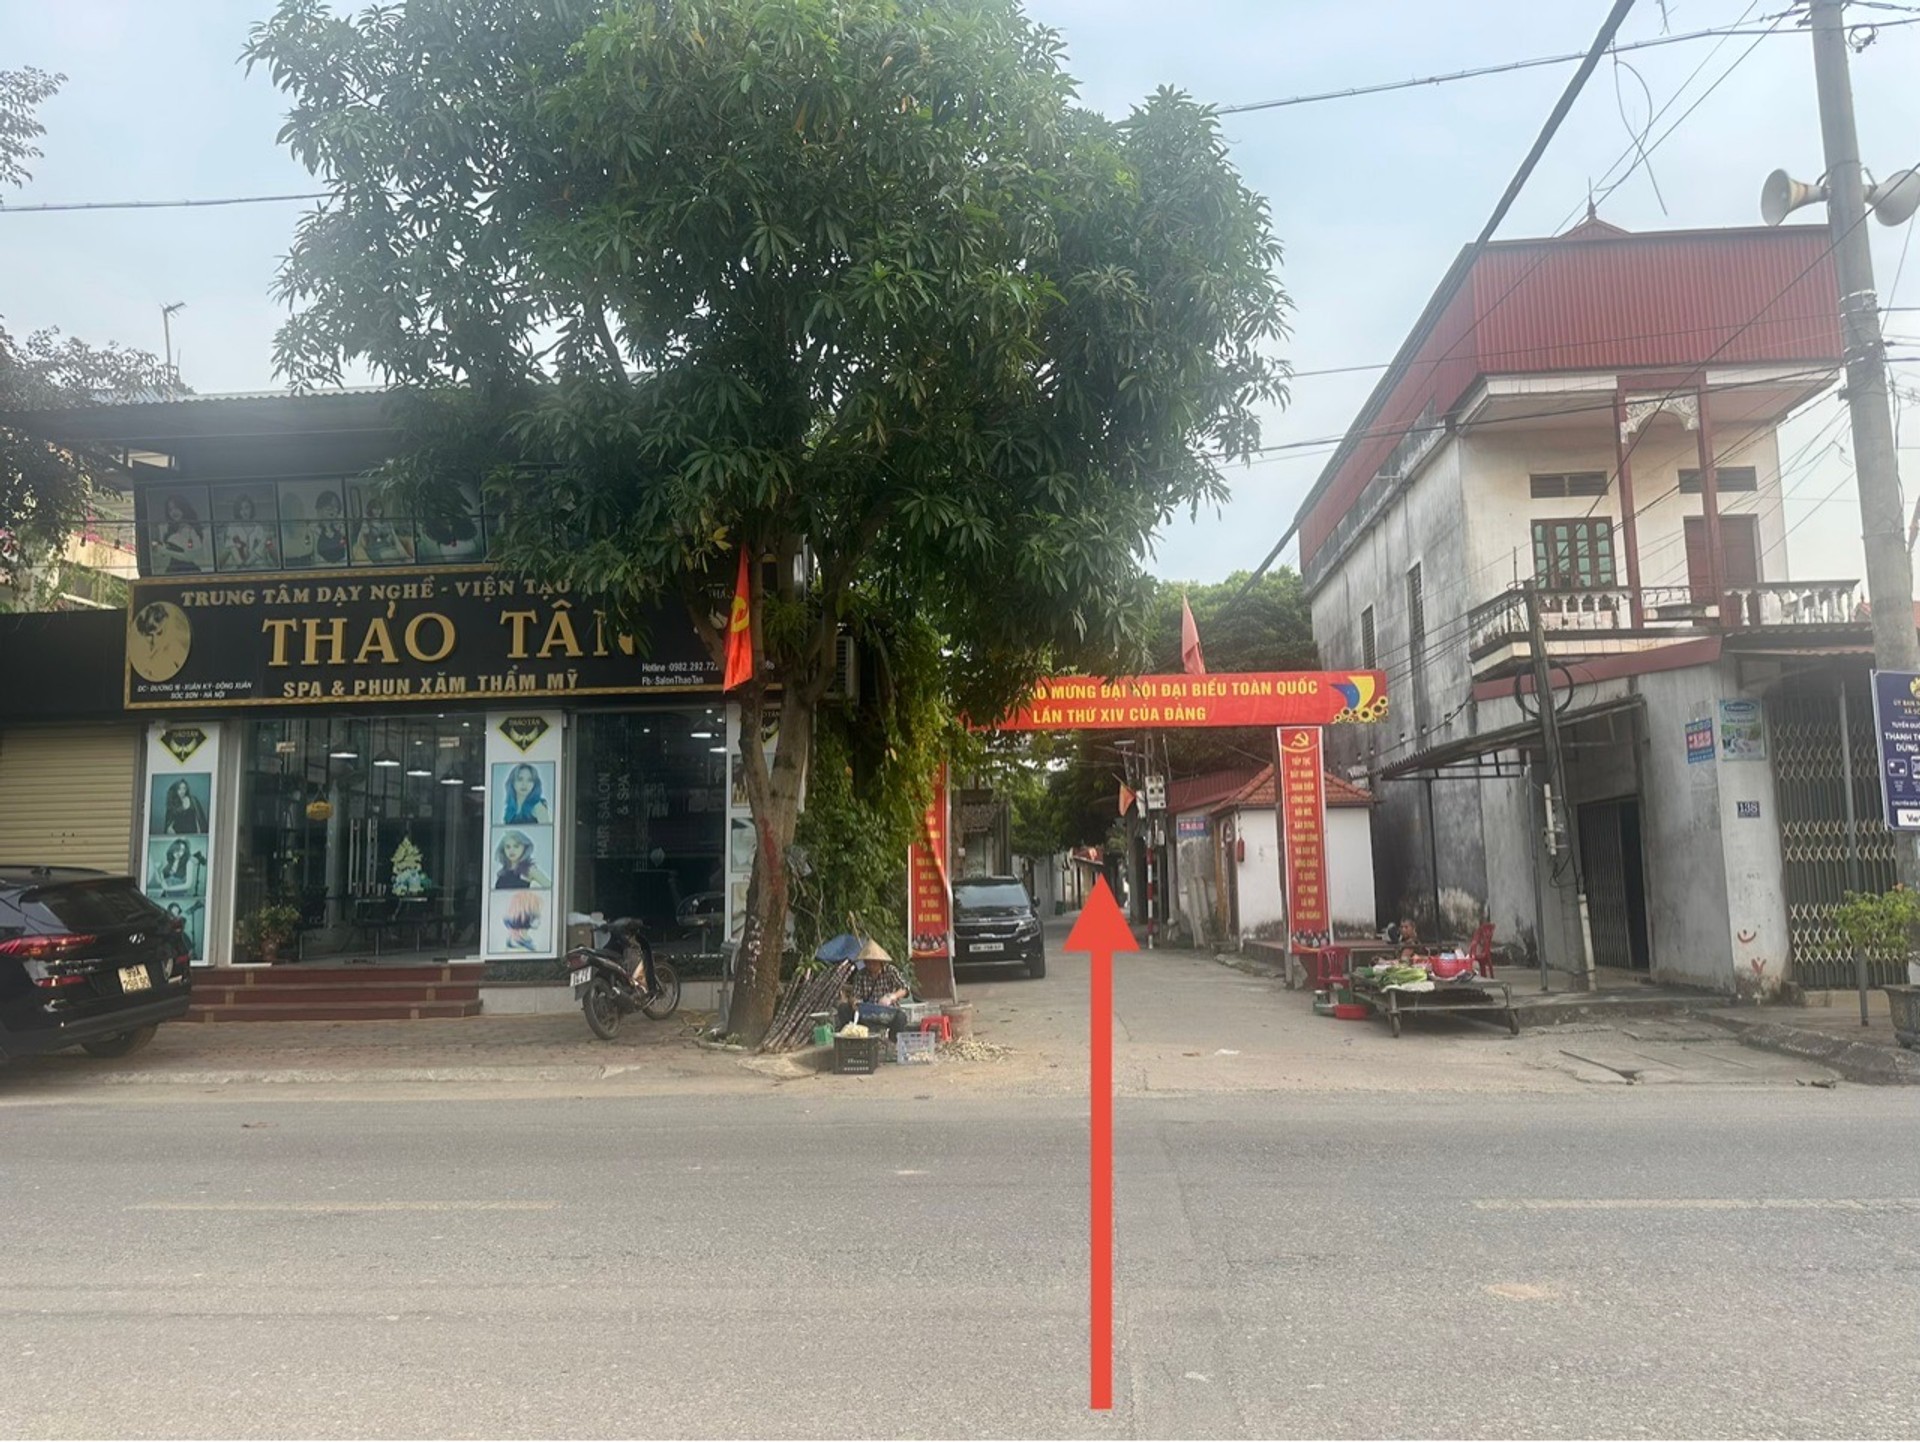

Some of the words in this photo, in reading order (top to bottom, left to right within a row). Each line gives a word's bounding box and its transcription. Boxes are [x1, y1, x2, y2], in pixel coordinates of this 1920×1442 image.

[181, 589, 256, 607] TRUNG
[262, 583, 310, 605] TÂM
[317, 585, 363, 608] DẠY
[370, 575, 436, 600] NGHỀ
[455, 575, 516, 602] VIỆN
[261, 600, 456, 666] THẢO
[282, 681, 322, 698] SPA
[330, 680, 345, 696] &
[354, 677, 410, 696] PHUN
[419, 671, 467, 694] XĂM
[477, 664, 537, 692] THẨM
[546, 668, 579, 690] MỸ
[1051, 683, 1097, 699] MỪNG
[1101, 683, 1126, 700] ĐẠI
[1161, 683, 1187, 700] ĐẠI
[1192, 677, 1227, 697] BIỂU
[1232, 678, 1272, 696] TOÀN
[1276, 676, 1319, 695] QUỐC
[1033, 704, 1062, 724] LẦN
[1067, 705, 1097, 723] THỨ
[1100, 707, 1125, 722] XIV
[1129, 703, 1160, 721] CỦA
[1164, 702, 1207, 721] ĐẢNG
